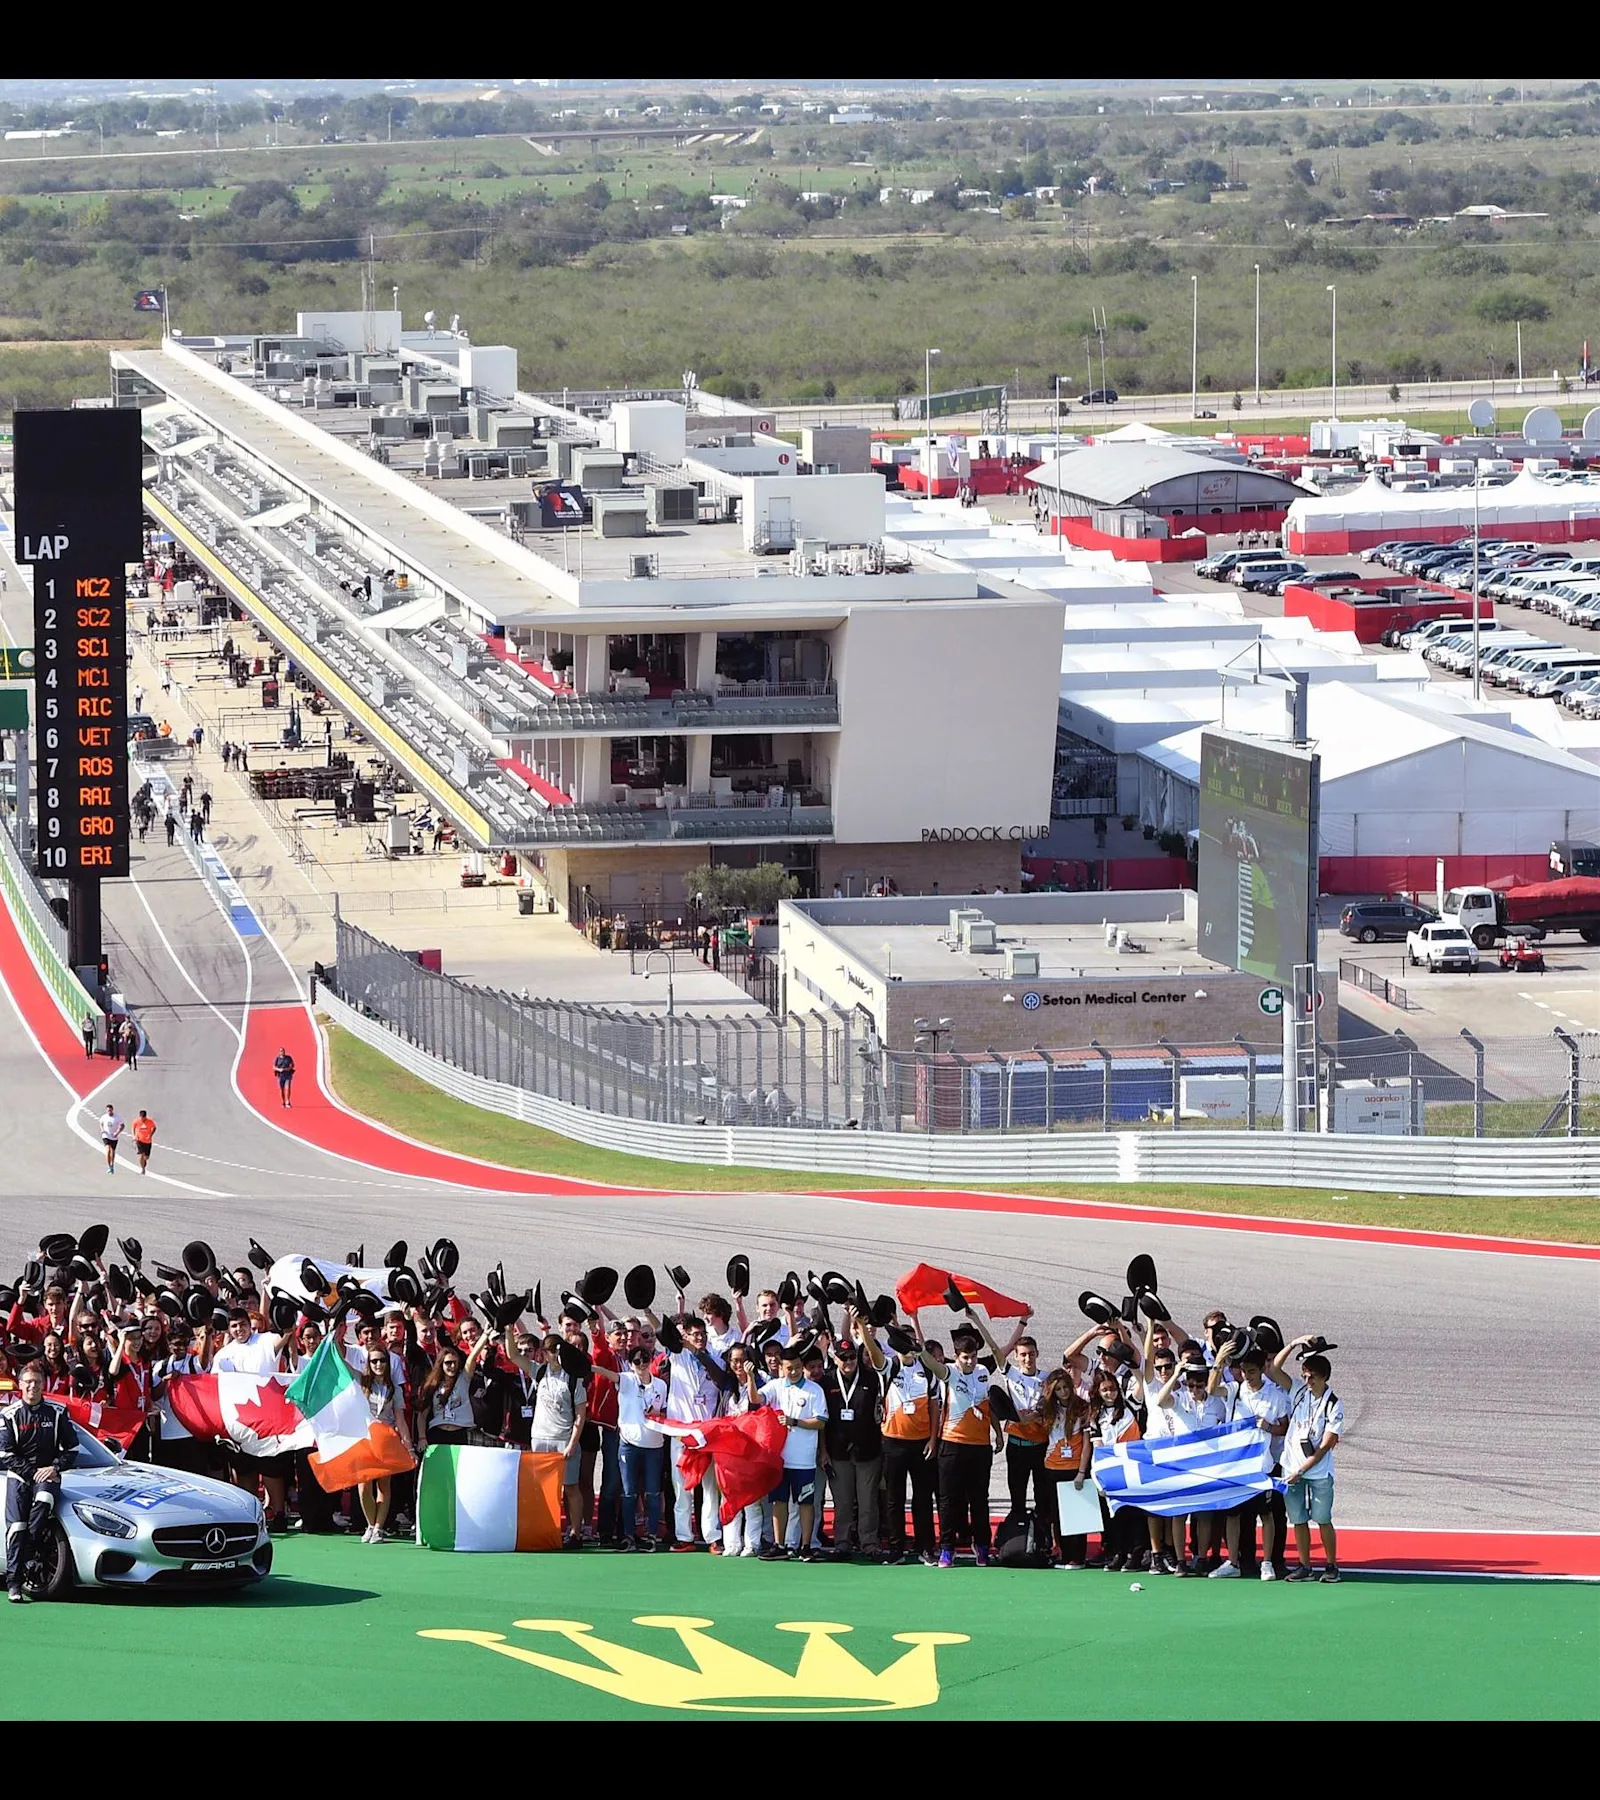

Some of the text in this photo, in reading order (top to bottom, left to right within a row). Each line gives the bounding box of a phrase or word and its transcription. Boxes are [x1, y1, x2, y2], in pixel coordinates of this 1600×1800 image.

[23, 535, 70, 560] LAP
[45, 578, 111, 599] 1 MC2
[44, 608, 111, 629] 2 SC2
[45, 638, 109, 659] 3 SC1
[45, 668, 110, 688] 4 MC1
[46, 698, 112, 719] 5 RIC
[46, 727, 111, 748] 6 VET
[46, 757, 114, 778] 7 ROS
[47, 787, 112, 808] 8 RAI
[48, 817, 114, 838] 9 GRO
[921, 825, 1050, 843] PADDOCK CLUB
[42, 846, 112, 868] 10 ERI
[1042, 991, 1187, 1006] Seton Medical Center
[1364, 1094, 1400, 1104] aggreko
[131, 1482, 193, 1507] Allianz
[208, 1560, 236, 1570] AMG
